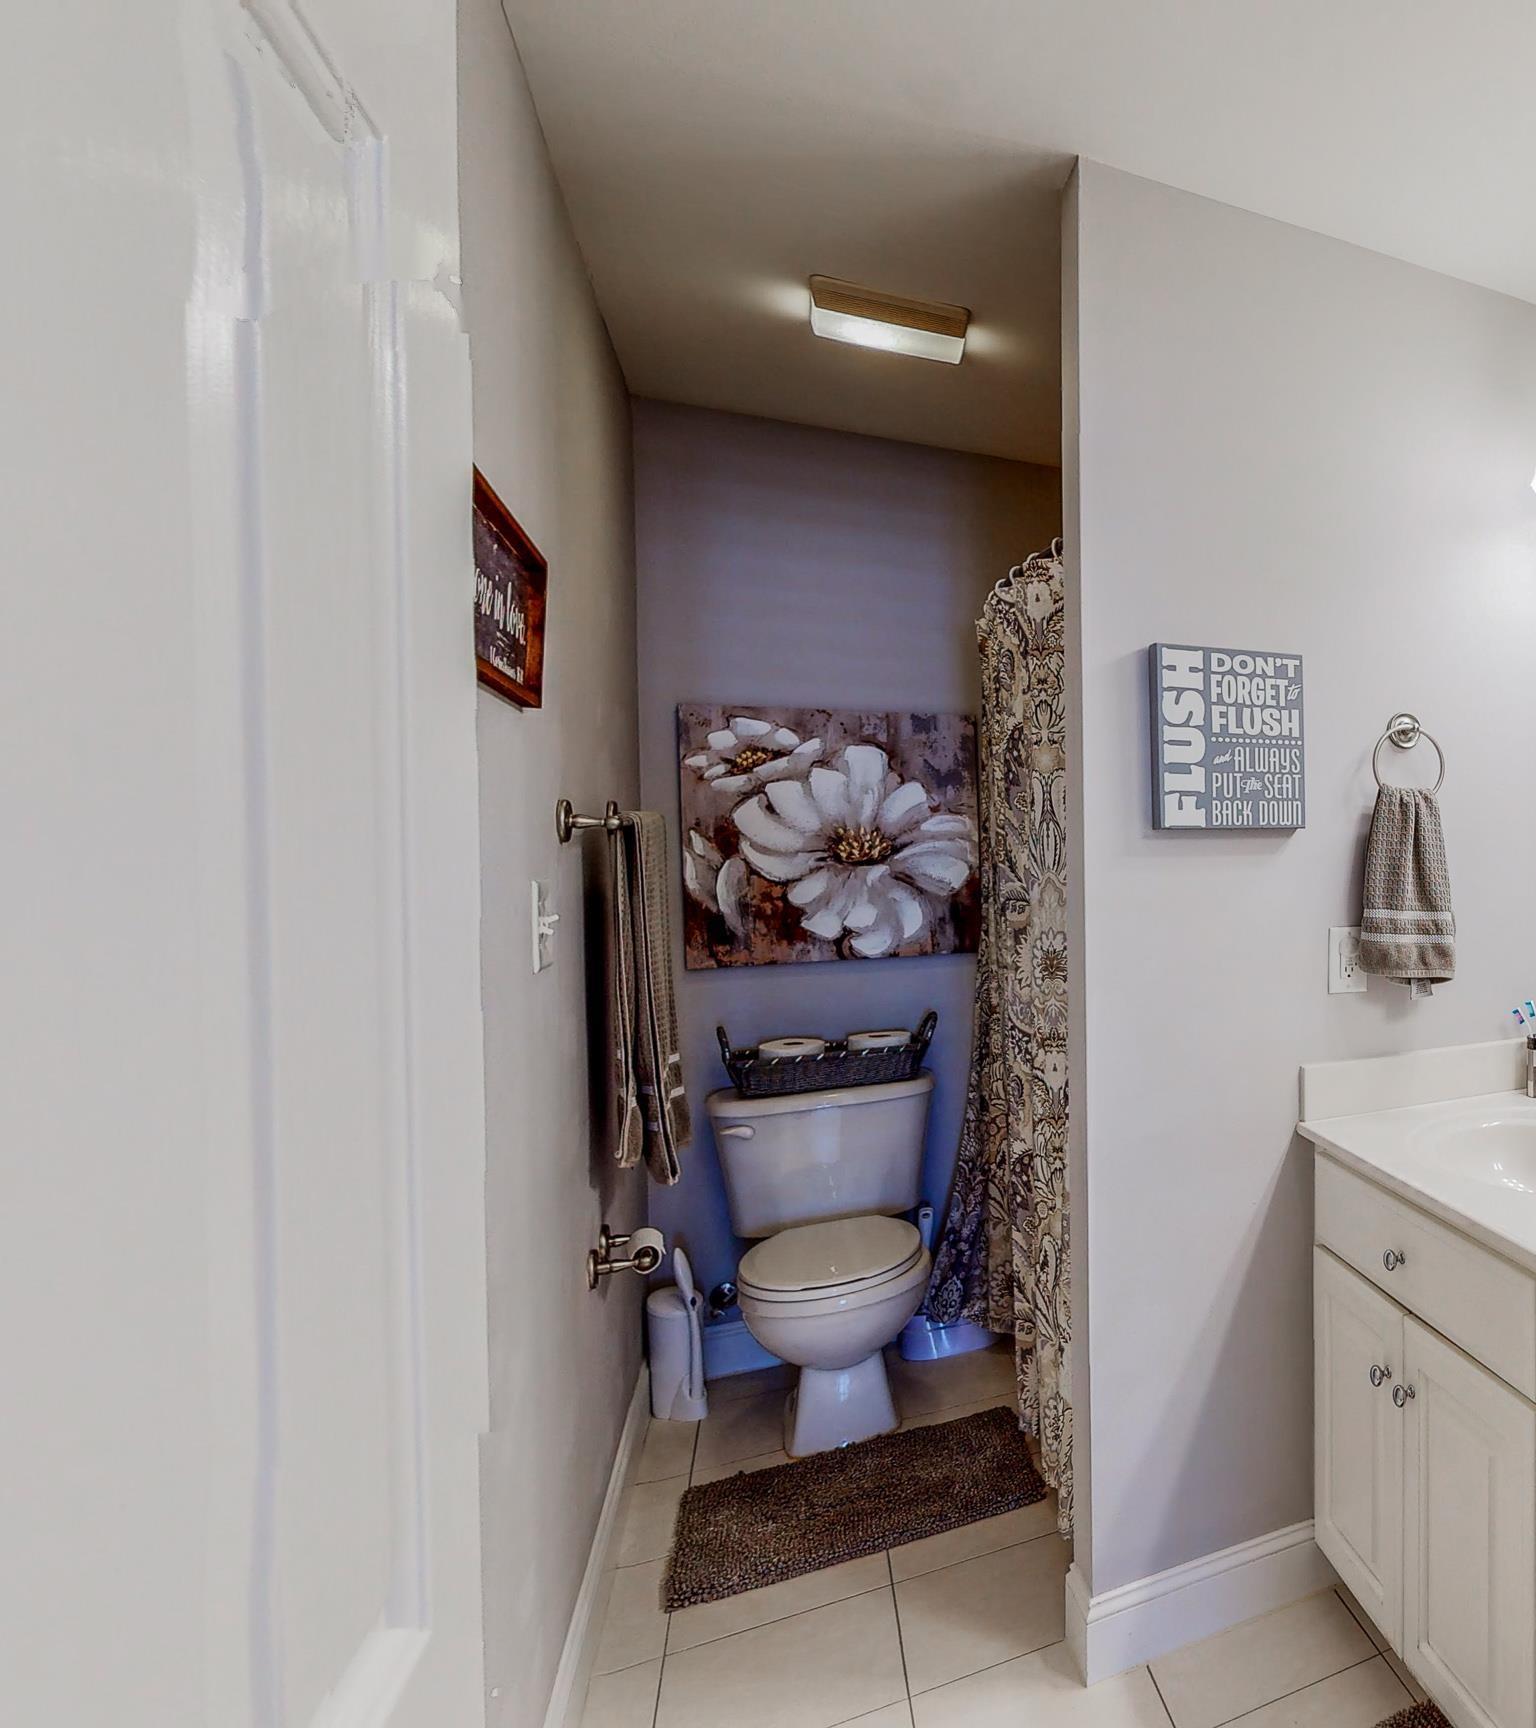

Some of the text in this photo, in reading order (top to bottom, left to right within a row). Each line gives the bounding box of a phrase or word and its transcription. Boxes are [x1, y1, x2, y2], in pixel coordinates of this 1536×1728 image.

[473, 568, 493, 615] one
[1210, 652, 1300, 678] DON'T
[1210, 674, 1302, 707] FORGET to
[1211, 705, 1300, 737] FLUSH
[1162, 647, 1206, 828] FLUSH
[1213, 747, 1300, 773] and ALWAYS
[1212, 772, 1243, 798] PUT
[1264, 773, 1301, 799] SEAT
[1212, 800, 1301, 826] BACK DOWN
